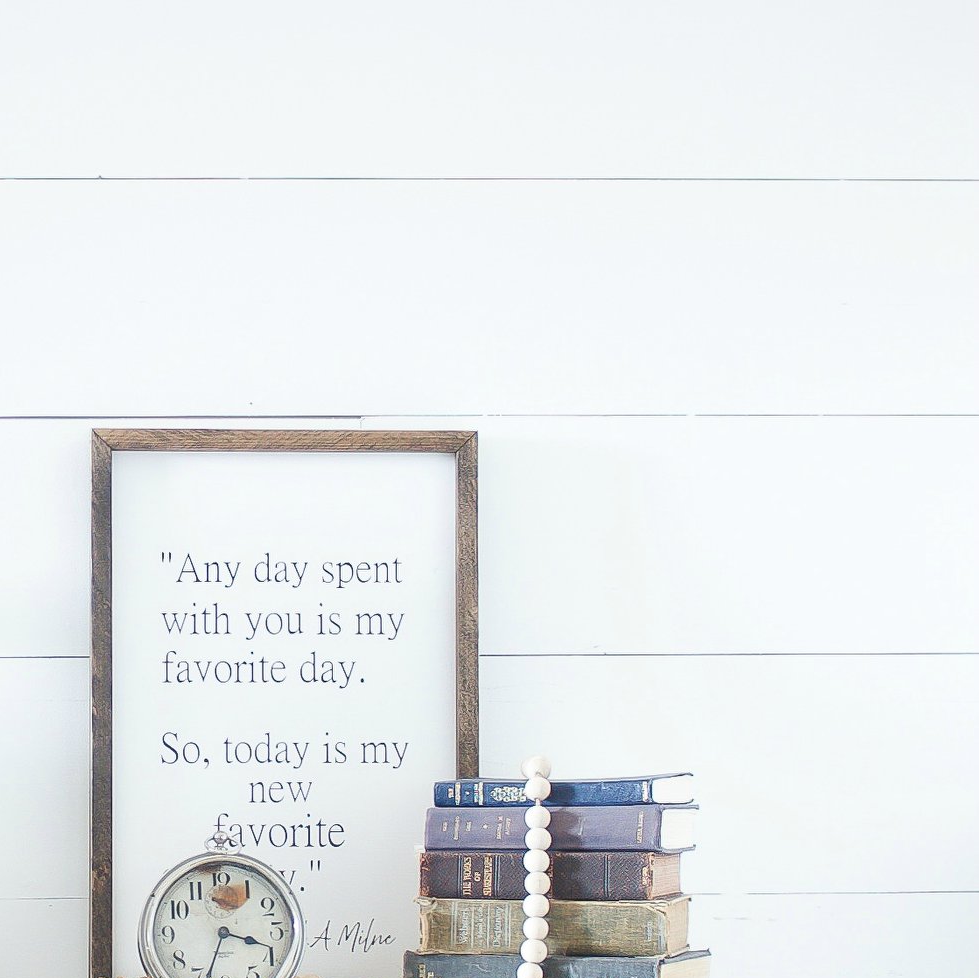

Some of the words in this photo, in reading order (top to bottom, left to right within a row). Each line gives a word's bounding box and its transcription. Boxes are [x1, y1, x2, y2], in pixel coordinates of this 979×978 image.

[161, 551, 241, 588] "Any
[254, 552, 308, 588] day
[322, 557, 403, 589] spent
[161, 602, 232, 635] with
[245, 612, 304, 641] you
[317, 602, 342, 635] is
[355, 612, 405, 641] my
[161, 650, 287, 684] favorite
[299, 651, 365, 689] day.
[161, 731, 210, 769] So,
[223, 732, 310, 769] today
[322, 732, 347, 764] is
[360, 741, 409, 769] my
[249, 781, 312, 804] new
[213, 813, 346, 848] favorite
[190, 881, 202, 901] 11
[244, 879, 251, 899] 1
[171, 900, 190, 920] 10
[261, 897, 275, 917] 2
[161, 926, 175, 945] 9
[269, 921, 284, 941] 3
[308, 919, 331, 951] A
[337, 918, 397, 953] Milne
[173, 949, 186, 970] 8
